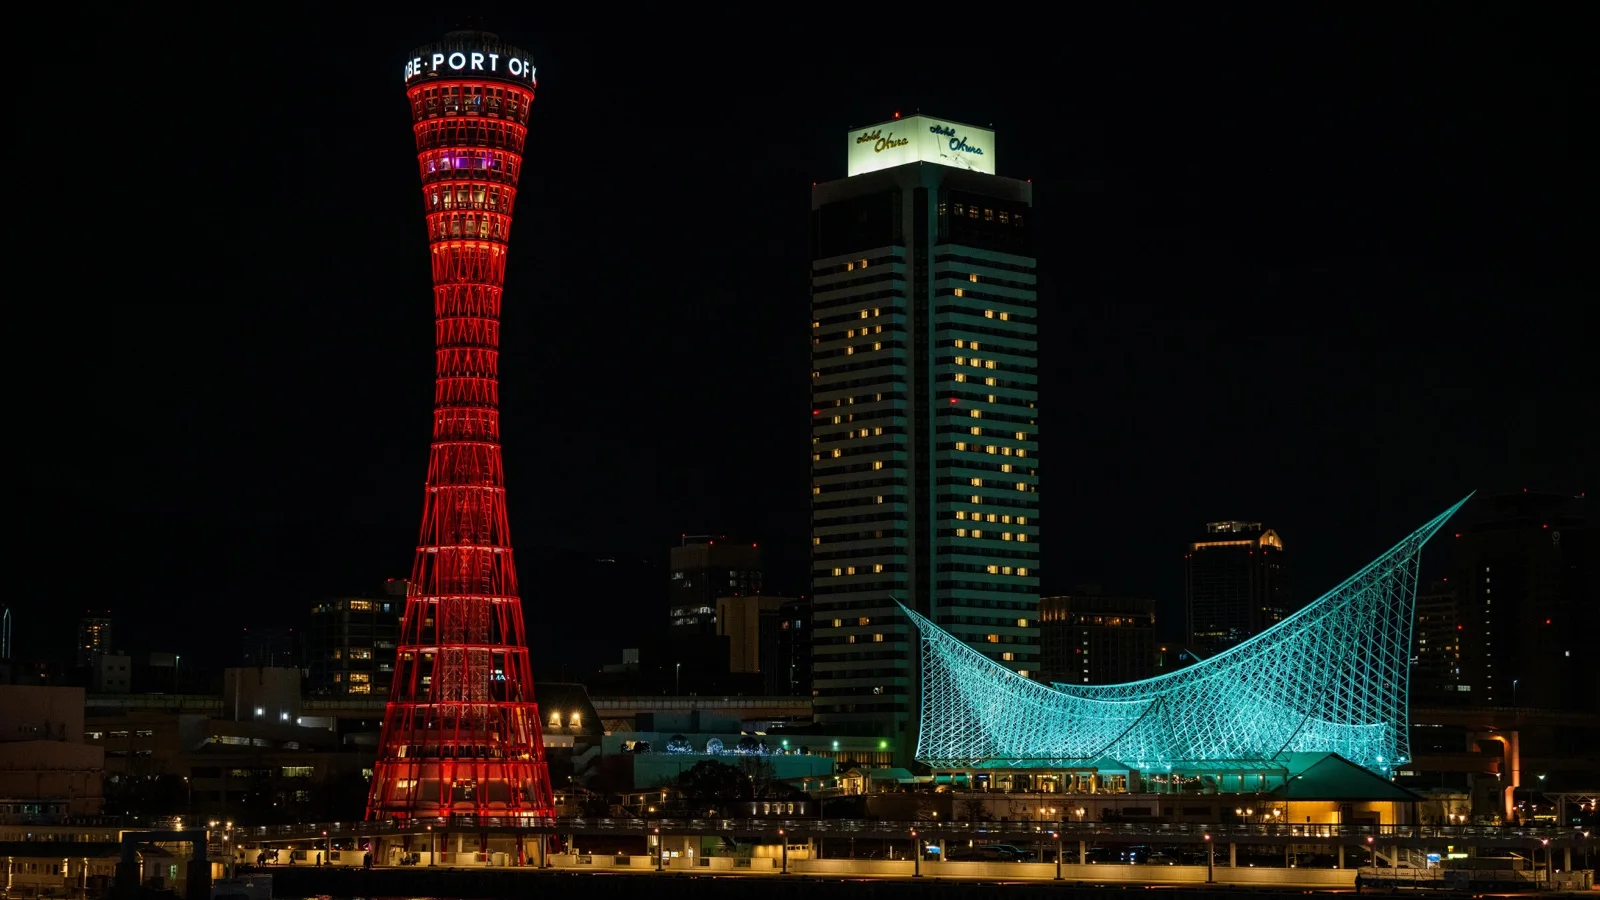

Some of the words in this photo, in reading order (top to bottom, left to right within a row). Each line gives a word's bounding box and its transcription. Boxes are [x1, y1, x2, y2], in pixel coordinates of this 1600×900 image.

[432, 52, 499, 71] PORT
[508, 57, 530, 78] OF
[856, 130, 882, 144] Hotel
[930, 125, 955, 137] Hotel
[874, 133, 909, 153] Okura
[949, 136, 984, 155] Okura
